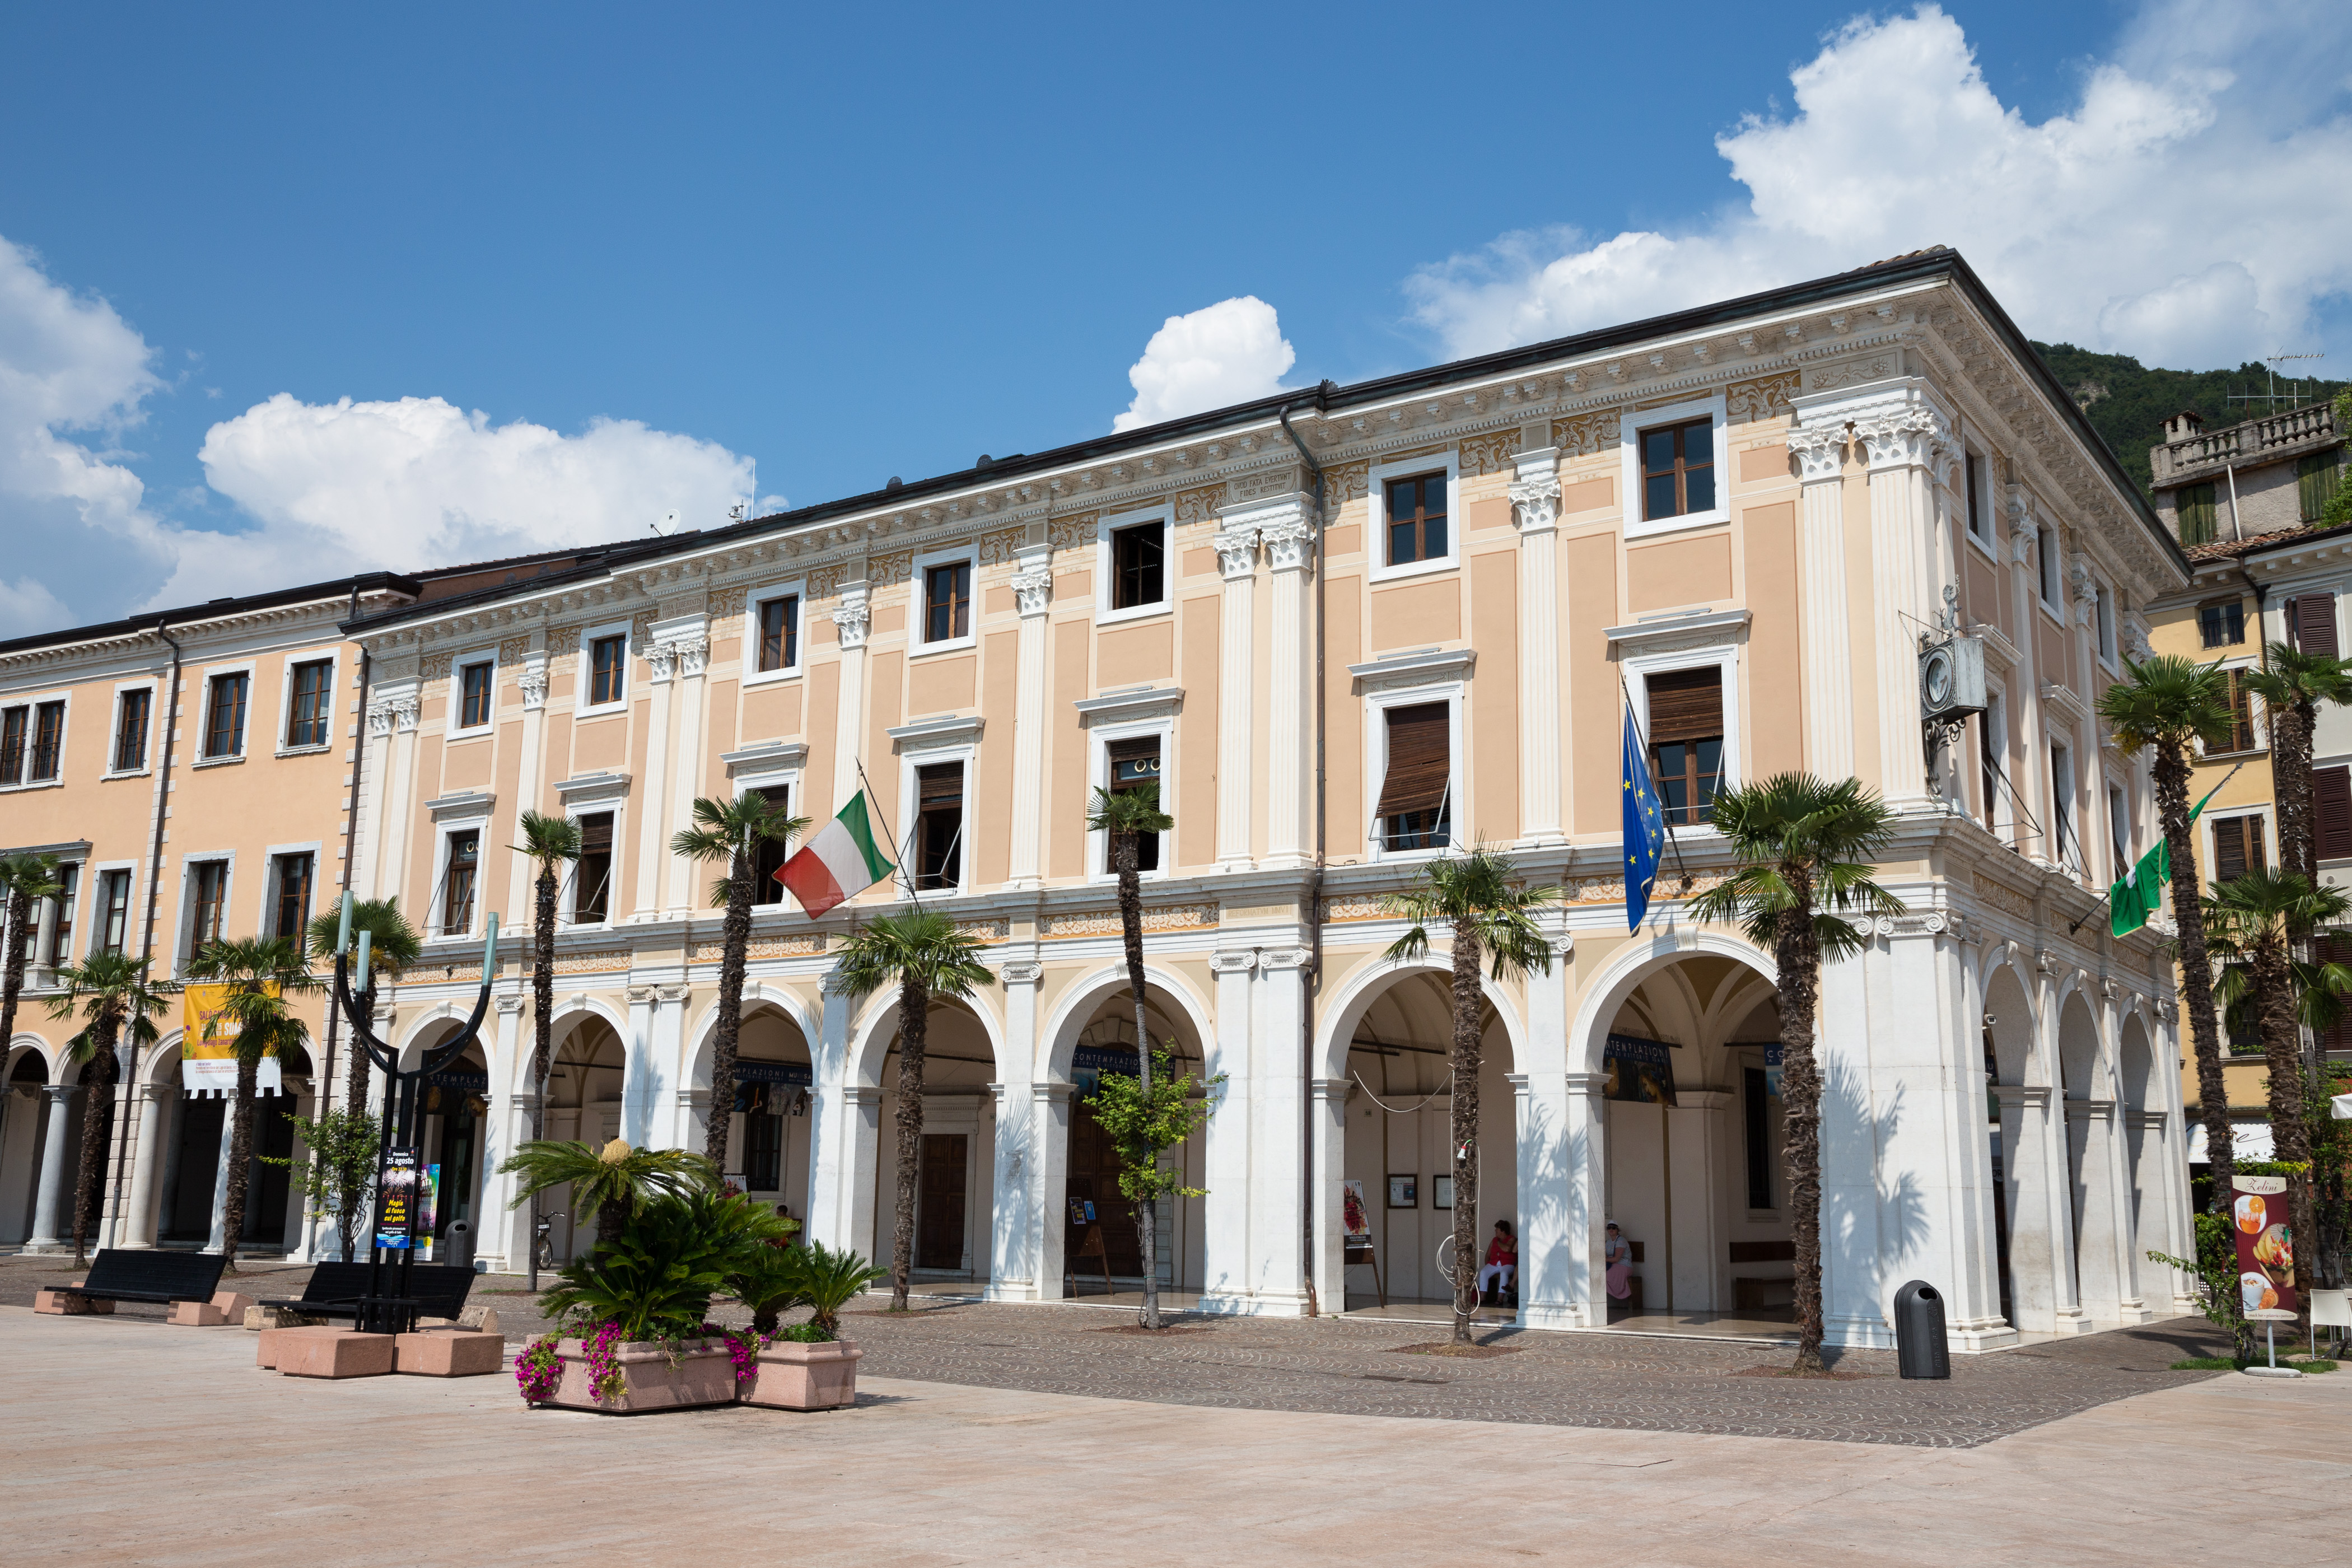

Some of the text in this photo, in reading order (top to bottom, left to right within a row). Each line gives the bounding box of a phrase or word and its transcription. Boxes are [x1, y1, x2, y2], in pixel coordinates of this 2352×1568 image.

[224, 1022, 242, 1036] SUM
[1074, 1053, 1139, 1066] CONTEMPLAZIO
[394, 1158, 414, 1166] agosto
